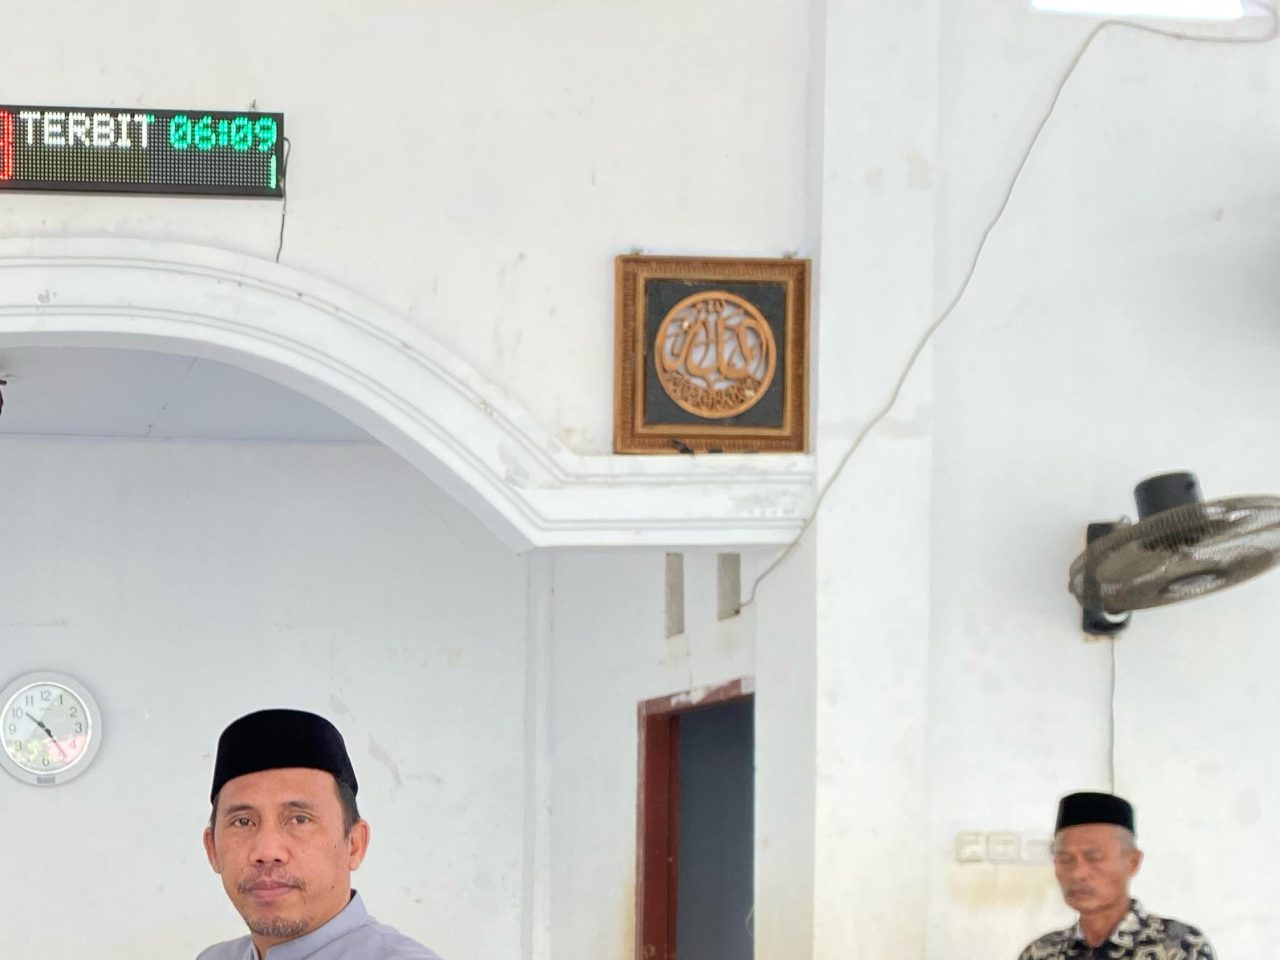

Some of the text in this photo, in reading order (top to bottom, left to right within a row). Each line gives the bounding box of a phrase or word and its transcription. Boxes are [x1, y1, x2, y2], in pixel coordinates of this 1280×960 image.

[19, 110, 278, 152] TERBIT 06:09
[25, 695, 34, 706] 11
[40, 690, 51, 701] 12
[12, 707, 24, 719] 10
[70, 706, 78, 718] 2
[8, 723, 16, 735] 9
[74, 722, 82, 734] 3
